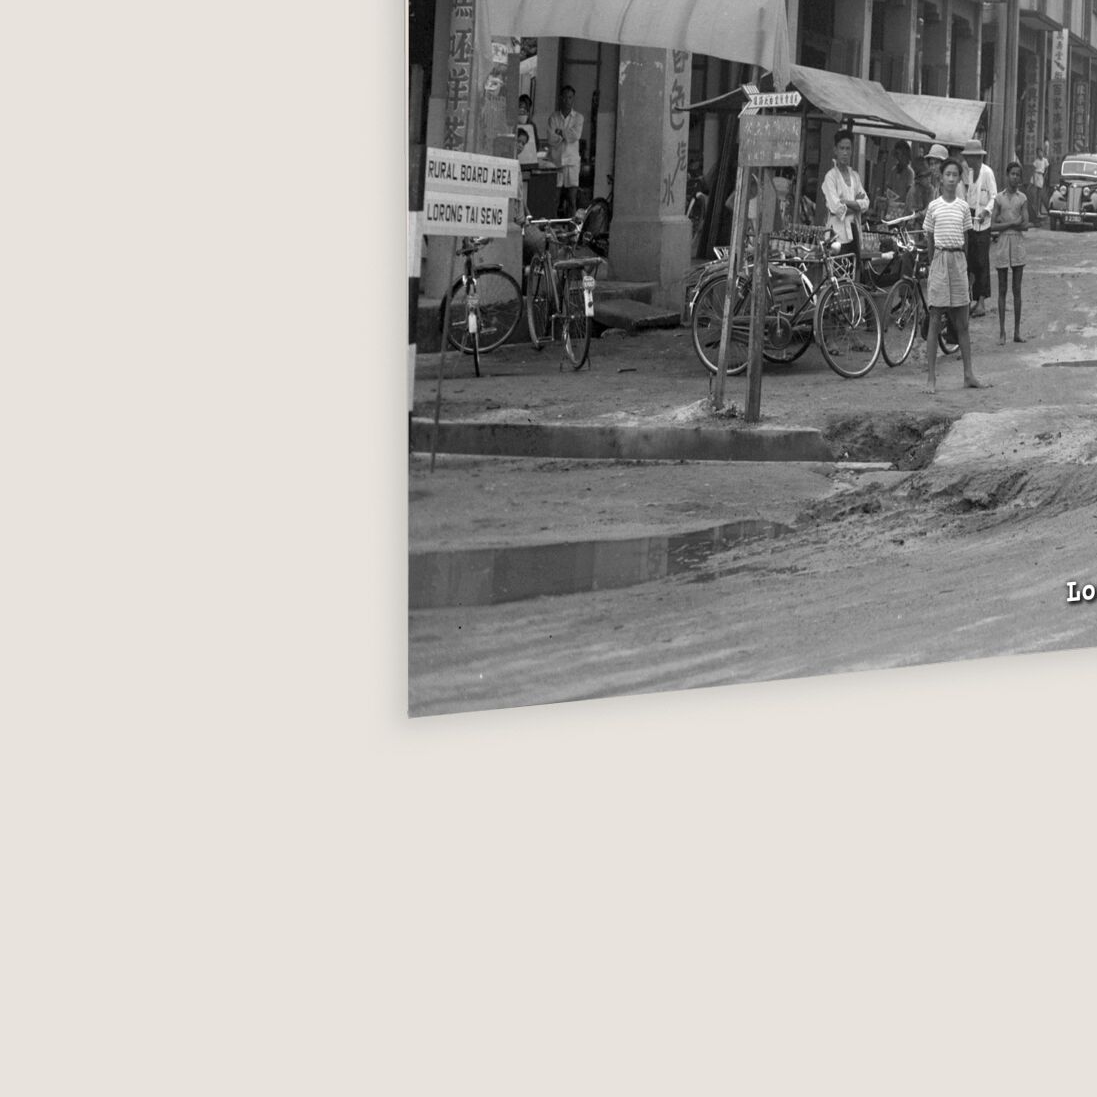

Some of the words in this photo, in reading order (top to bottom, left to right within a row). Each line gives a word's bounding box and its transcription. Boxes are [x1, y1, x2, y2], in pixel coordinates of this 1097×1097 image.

[428, 160, 457, 181] RURAL
[460, 164, 488, 184] BOARD
[491, 167, 511, 186] AREA
[427, 203, 463, 223] LORONG
[465, 205, 478, 224] TAI
[480, 206, 503, 225] SENG
